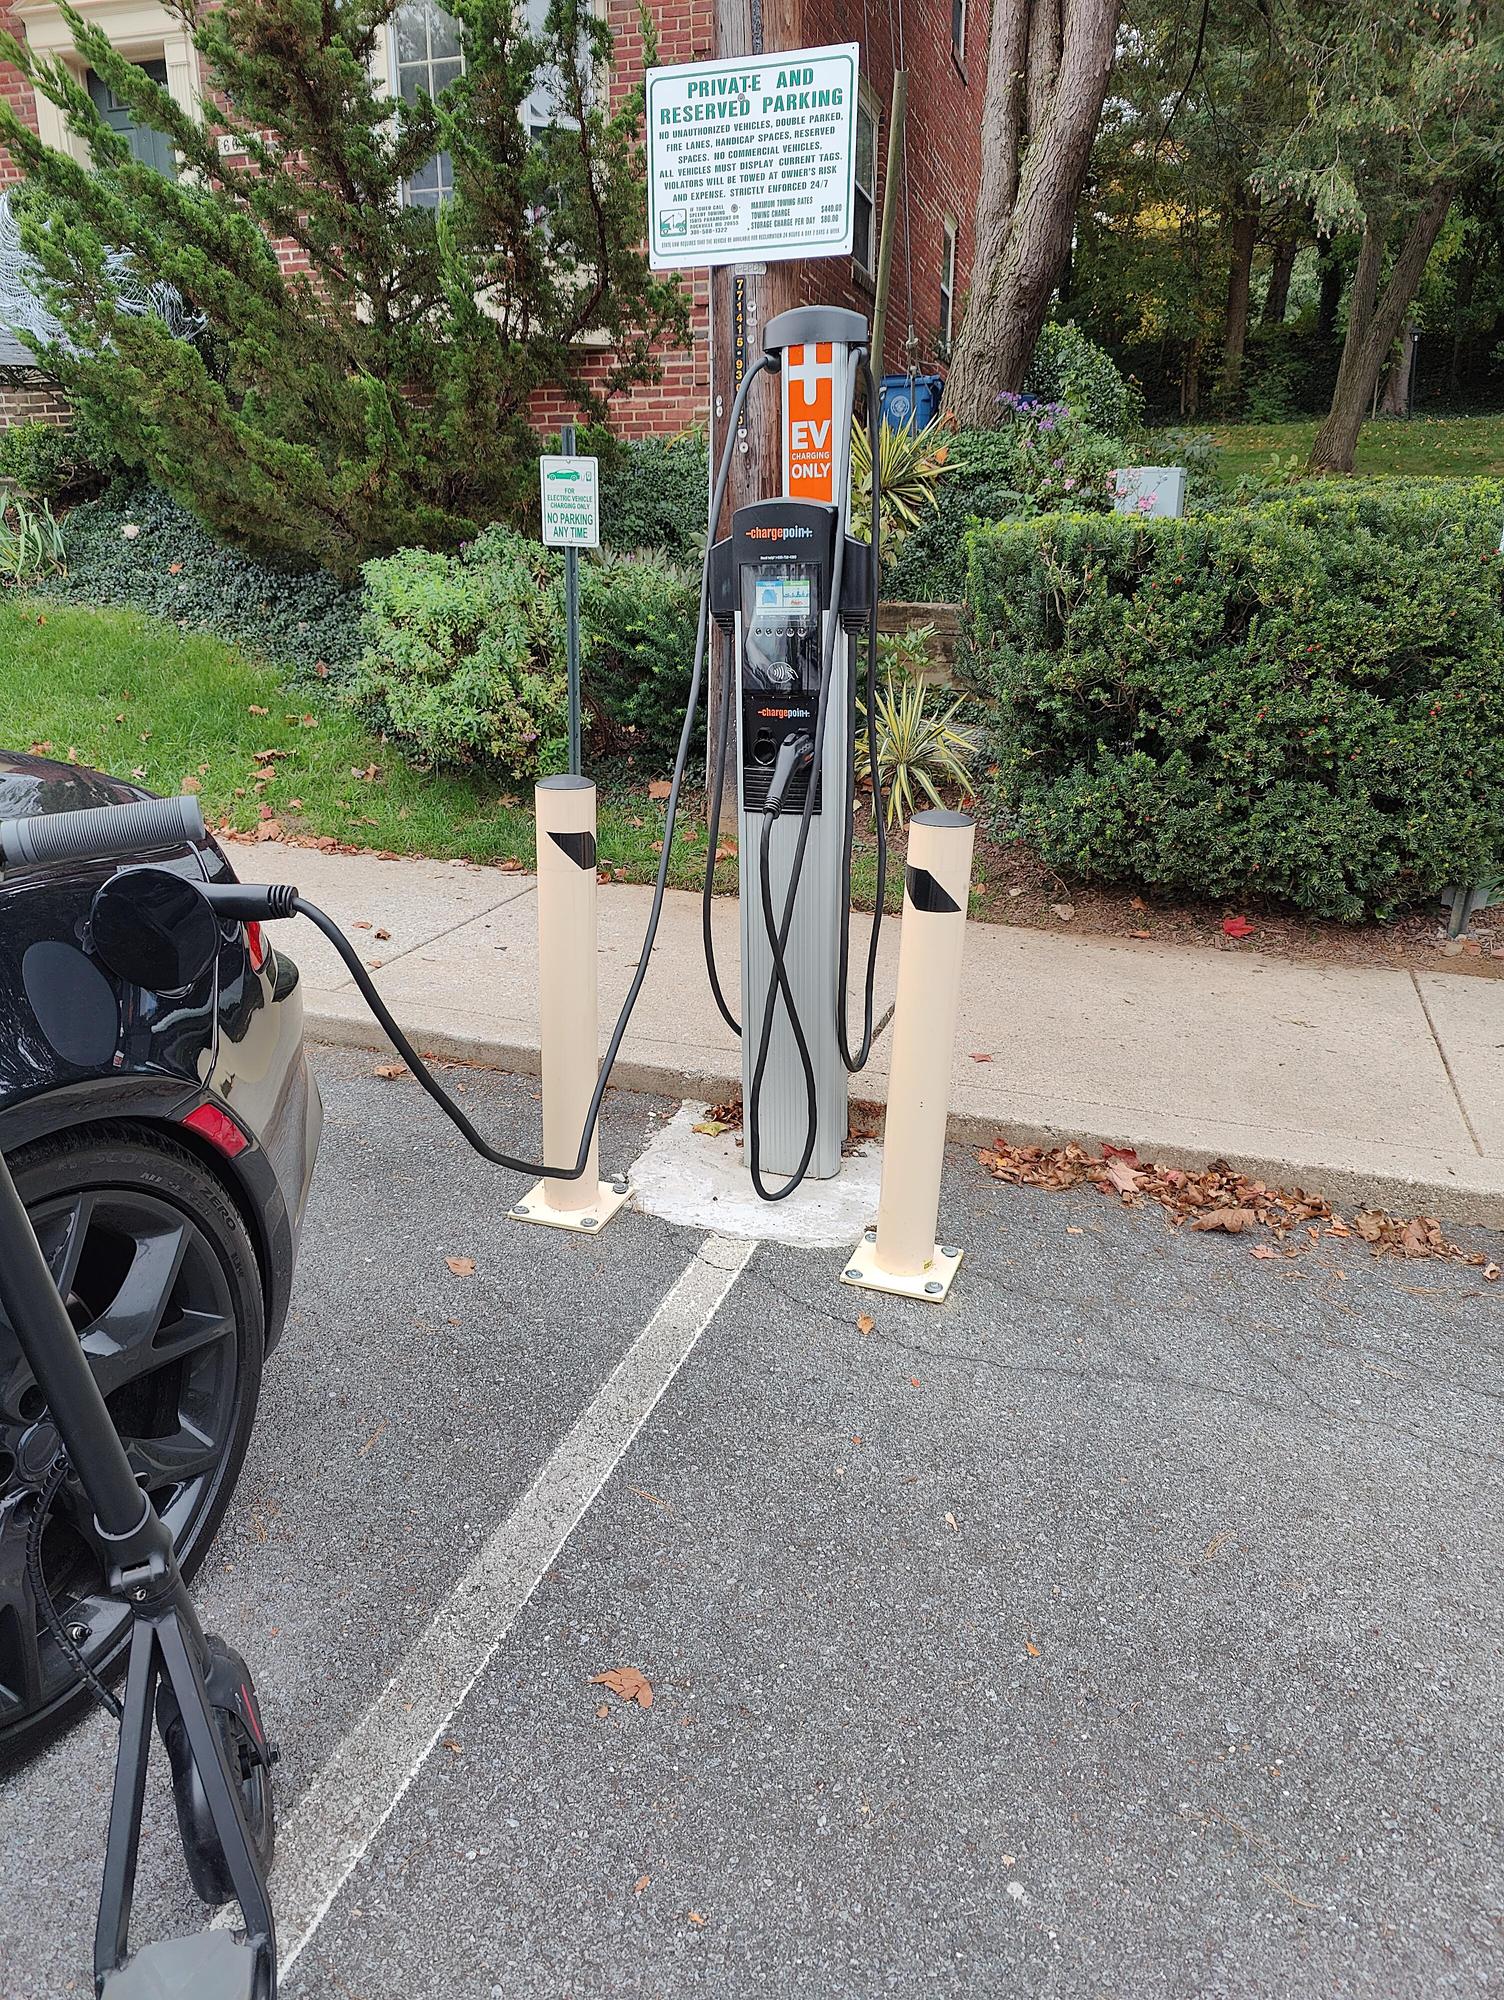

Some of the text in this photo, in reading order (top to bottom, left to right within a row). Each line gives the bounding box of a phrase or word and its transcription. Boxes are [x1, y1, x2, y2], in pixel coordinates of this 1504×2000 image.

[688, 68, 814, 99] PRIVATE AND
[660, 88, 843, 125] RESERVED PARKING
[659, 131, 669, 139] NO
[673, 124, 730, 138] UNAUTHORIZED
[776, 116, 805, 127] DOUBLE
[666, 143, 682, 152] FIRE
[716, 134, 755, 147] HANDICAP
[795, 126, 835, 138] RESERVED
[714, 152, 725, 160] NO
[728, 145, 780, 159] COMMERCIAL
[660, 170, 674, 178] ALL
[678, 166, 711, 176] VEHICLES
[715, 163, 736, 173] MUST
[740, 159, 774, 171] DISPLAY
[779, 155, 815, 166] CURRENT
[664, 165, 836, 190] VIOLATORS WILL BE TOWED AT OWNER'S RISK
[673, 193, 687, 202] AND
[730, 184, 765, 198] STRICTLY
[768, 182, 807, 193] ENFORCED
[810, 180, 828, 189] 24/7
[751, 196, 813, 209] MAXIMUM TOWING RATES
[751, 221, 772, 229] STORAGE
[774, 218, 792, 227] CHARGE
[795, 218, 804, 226] PER
[806, 217, 815, 225] DAY
[752, 211, 769, 219] TOWING
[772, 209, 790, 217] CHARGE
[792, 420, 831, 450] EV
[792, 451, 830, 460] CHARGING
[792, 462, 831, 479] ONLY
[547, 512, 593, 525] NO PARKING
[553, 526, 588, 538] ANY TIME
[199, 1186, 237, 1232] ZERO
